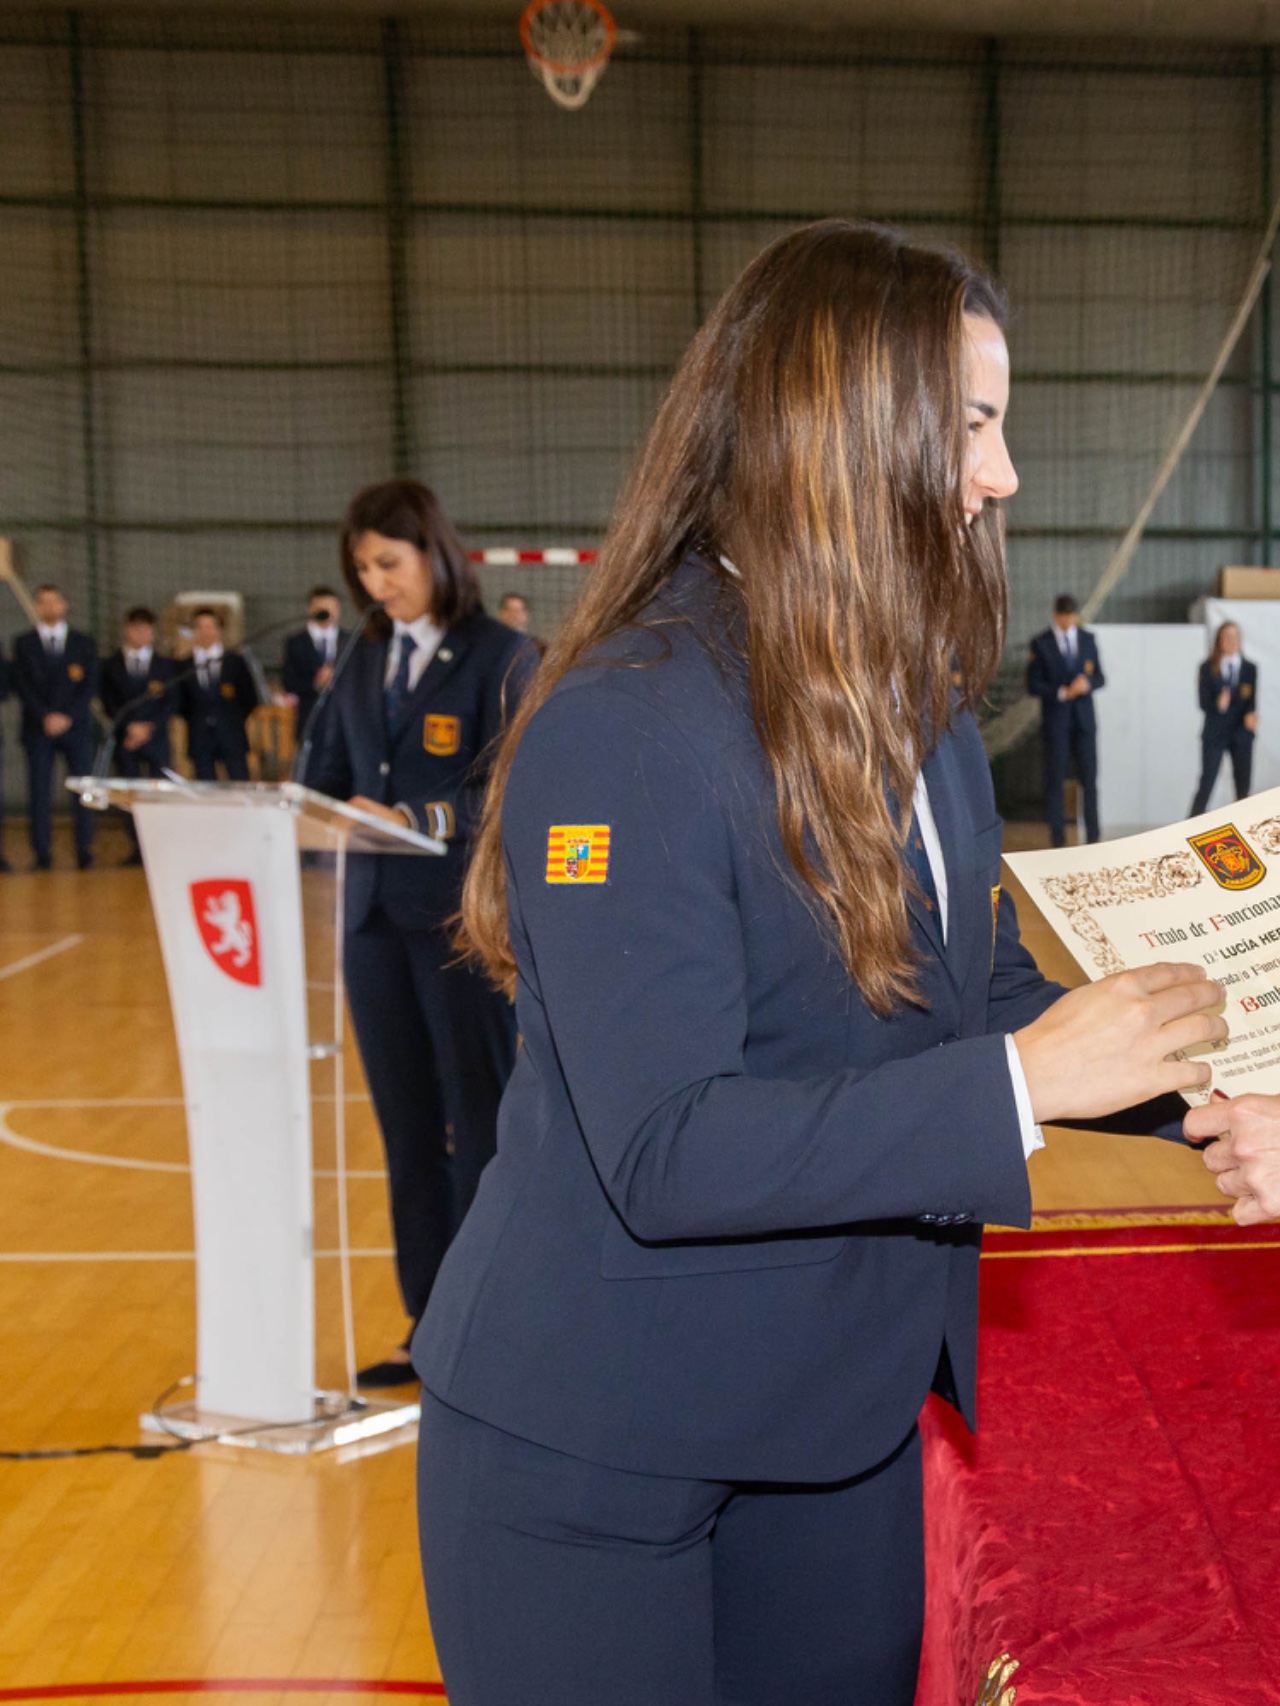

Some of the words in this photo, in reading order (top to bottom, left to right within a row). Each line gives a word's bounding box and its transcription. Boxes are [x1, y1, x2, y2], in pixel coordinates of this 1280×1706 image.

[1138, 927, 1189, 949] Título
[1189, 921, 1209, 938] de
[1219, 938, 1260, 960] LUCÍA
